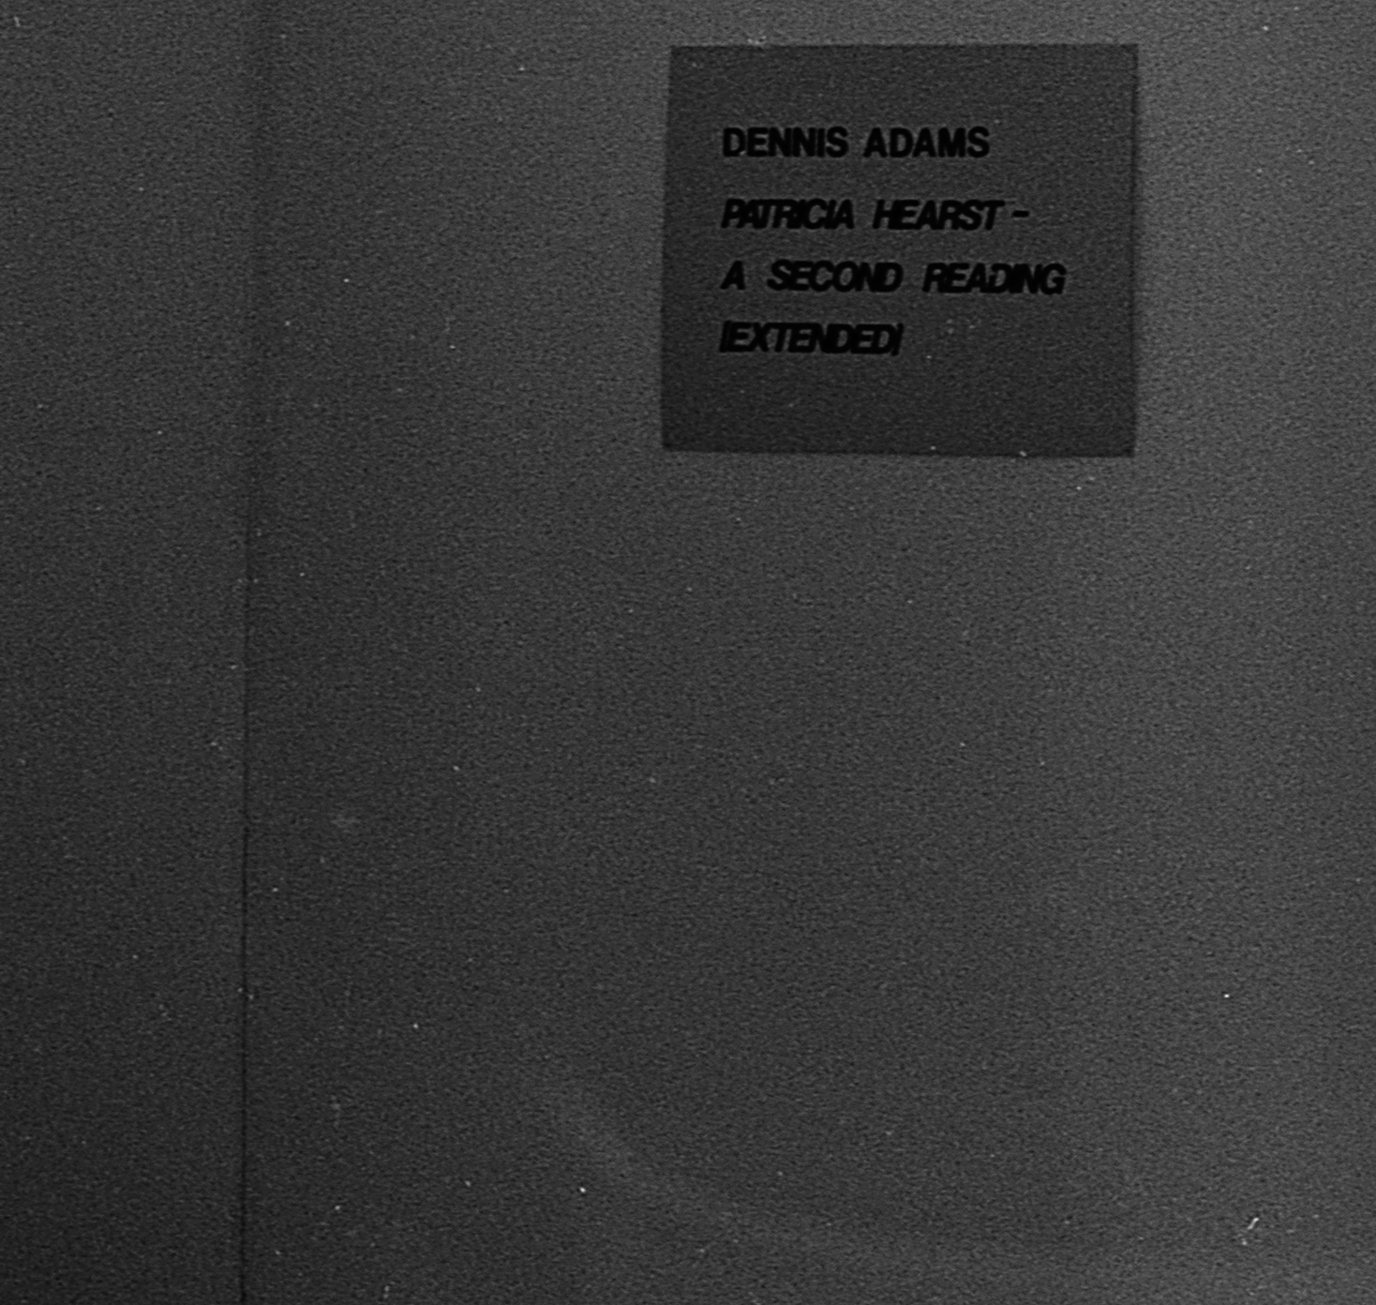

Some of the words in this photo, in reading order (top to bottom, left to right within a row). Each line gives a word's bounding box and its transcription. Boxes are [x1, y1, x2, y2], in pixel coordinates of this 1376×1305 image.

[722, 126, 849, 158] DENNIS
[863, 126, 991, 158] ADAMS
[721, 198, 855, 230] PATRICIA
[872, 198, 1006, 231] HEARST
[720, 260, 746, 291] A
[767, 259, 904, 293] SECOND
[922, 262, 1067, 296] READING
